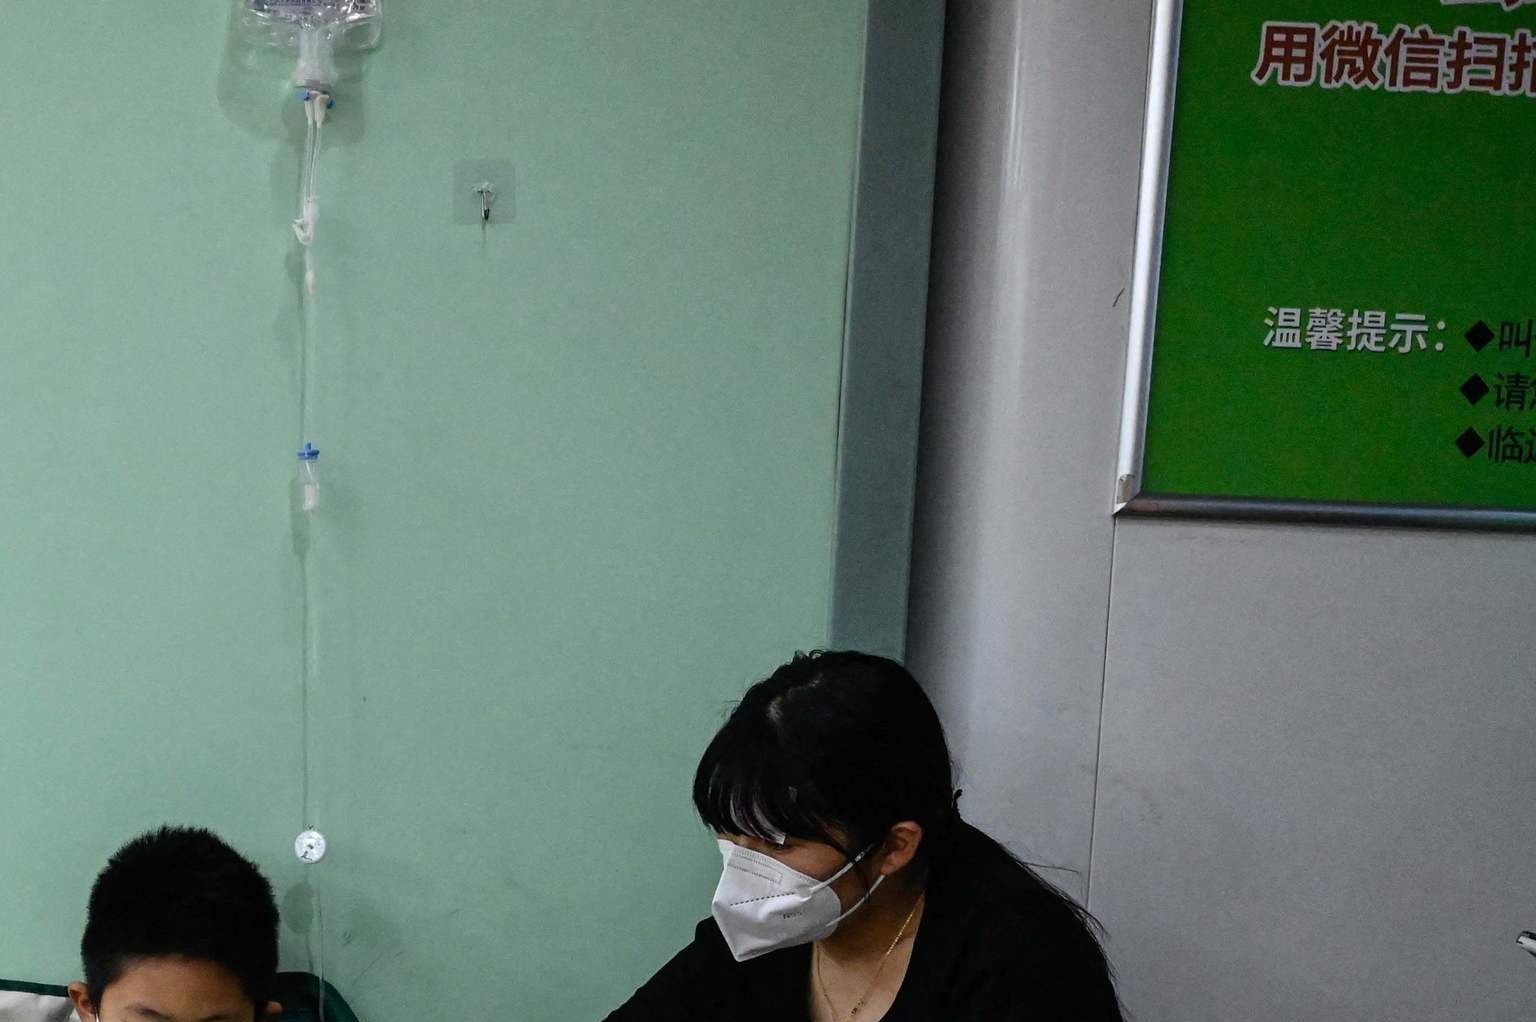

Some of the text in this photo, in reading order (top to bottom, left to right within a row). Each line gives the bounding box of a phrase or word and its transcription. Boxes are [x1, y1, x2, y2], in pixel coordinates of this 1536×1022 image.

[1263, 305, 1446, 353] 温馨提示：
[1492, 371, 1536, 411] 请
